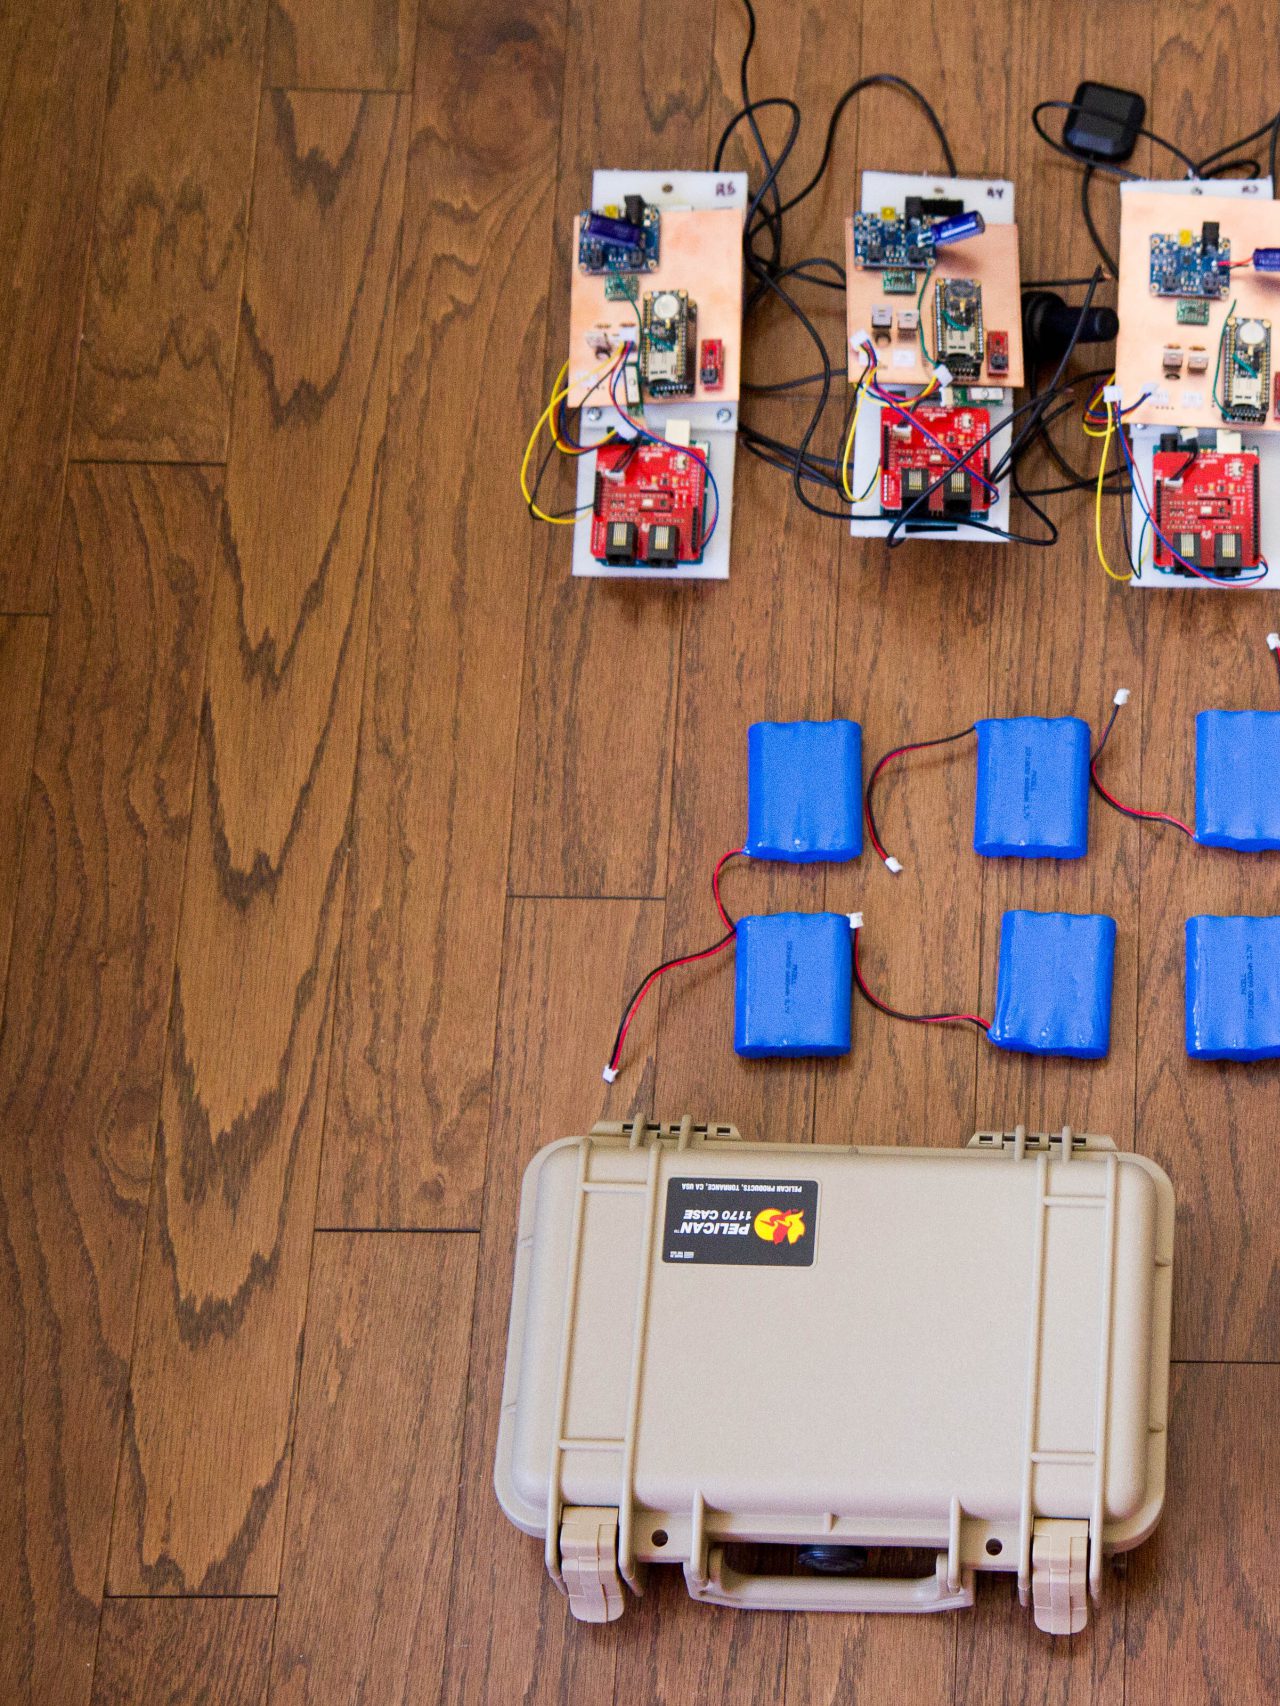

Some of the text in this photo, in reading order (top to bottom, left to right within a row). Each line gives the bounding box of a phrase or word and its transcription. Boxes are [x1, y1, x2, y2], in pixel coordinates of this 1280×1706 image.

[741, 1184, 776, 1192] PRODUCTS,
[776, 1185, 803, 1193] PELICAN
[683, 1209, 752, 1220] 1170 CASE
